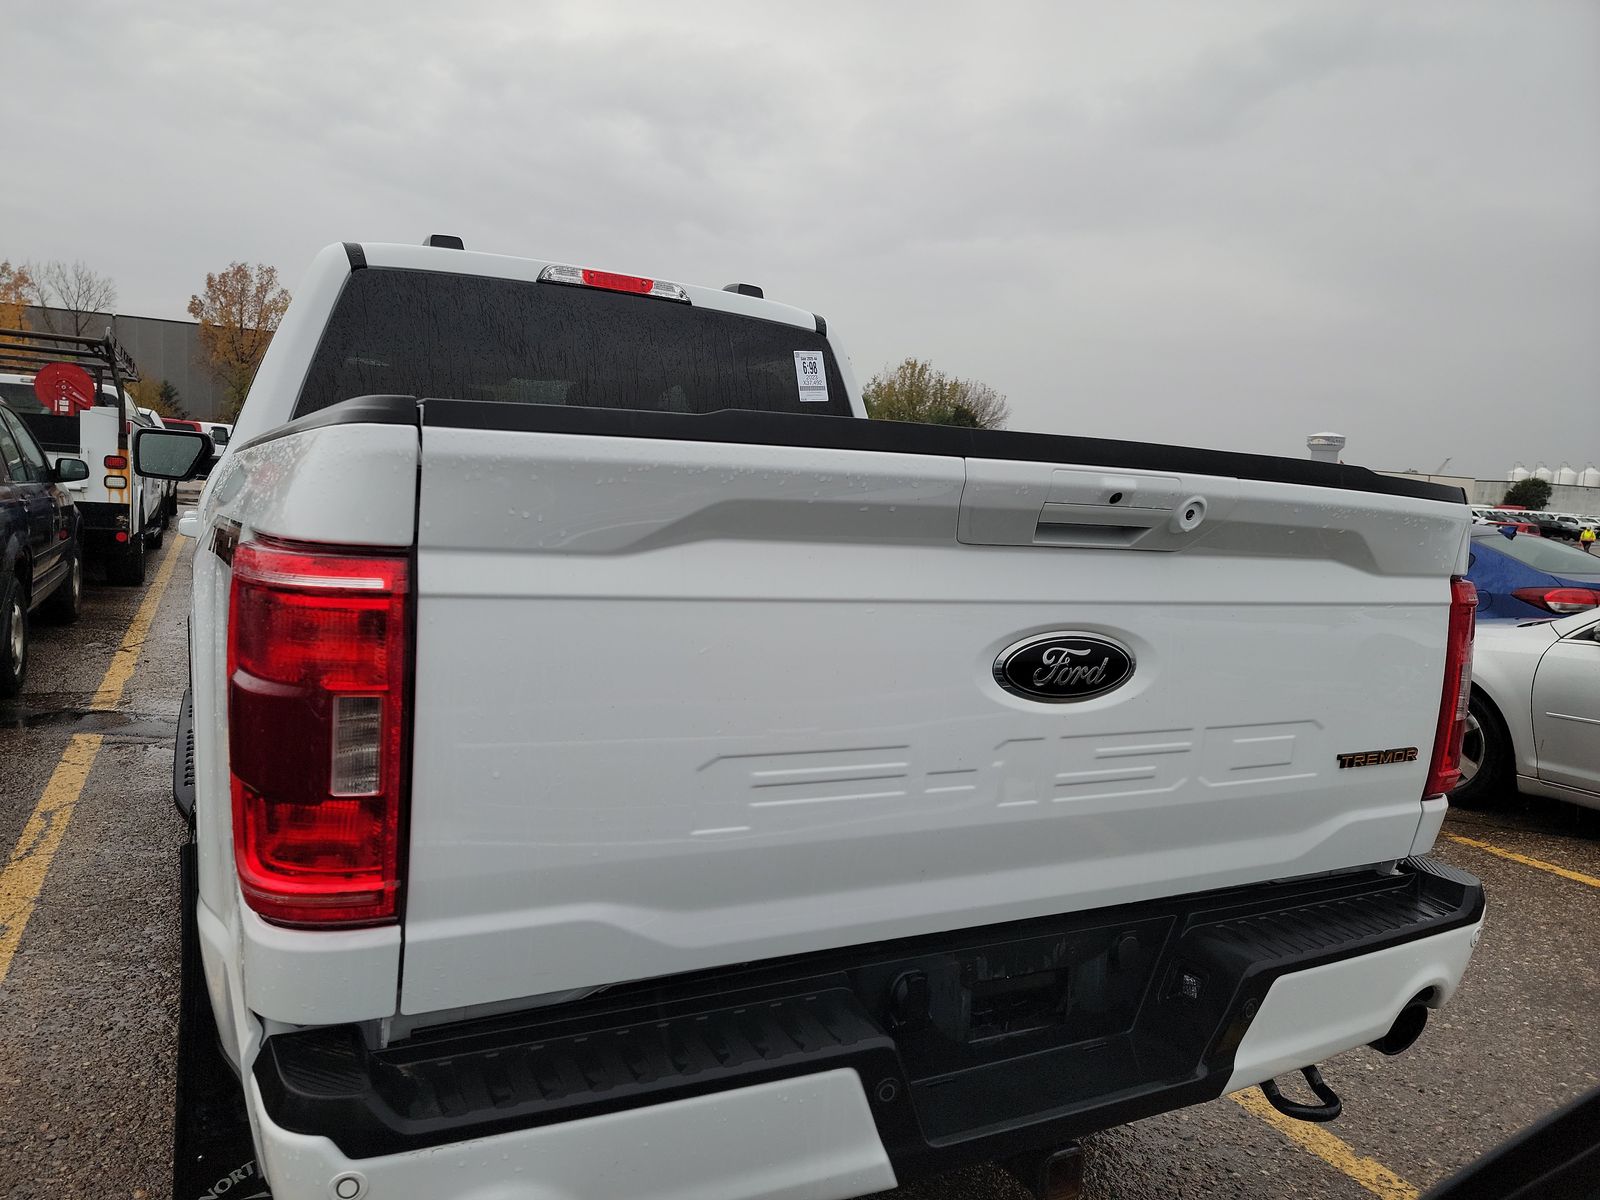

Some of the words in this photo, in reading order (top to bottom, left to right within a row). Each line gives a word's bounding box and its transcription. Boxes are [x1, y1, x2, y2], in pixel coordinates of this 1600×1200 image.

[802, 361, 818, 374] 6:98
[1033, 647, 1109, 686] Ford
[1337, 747, 1418, 768] TREMOR
